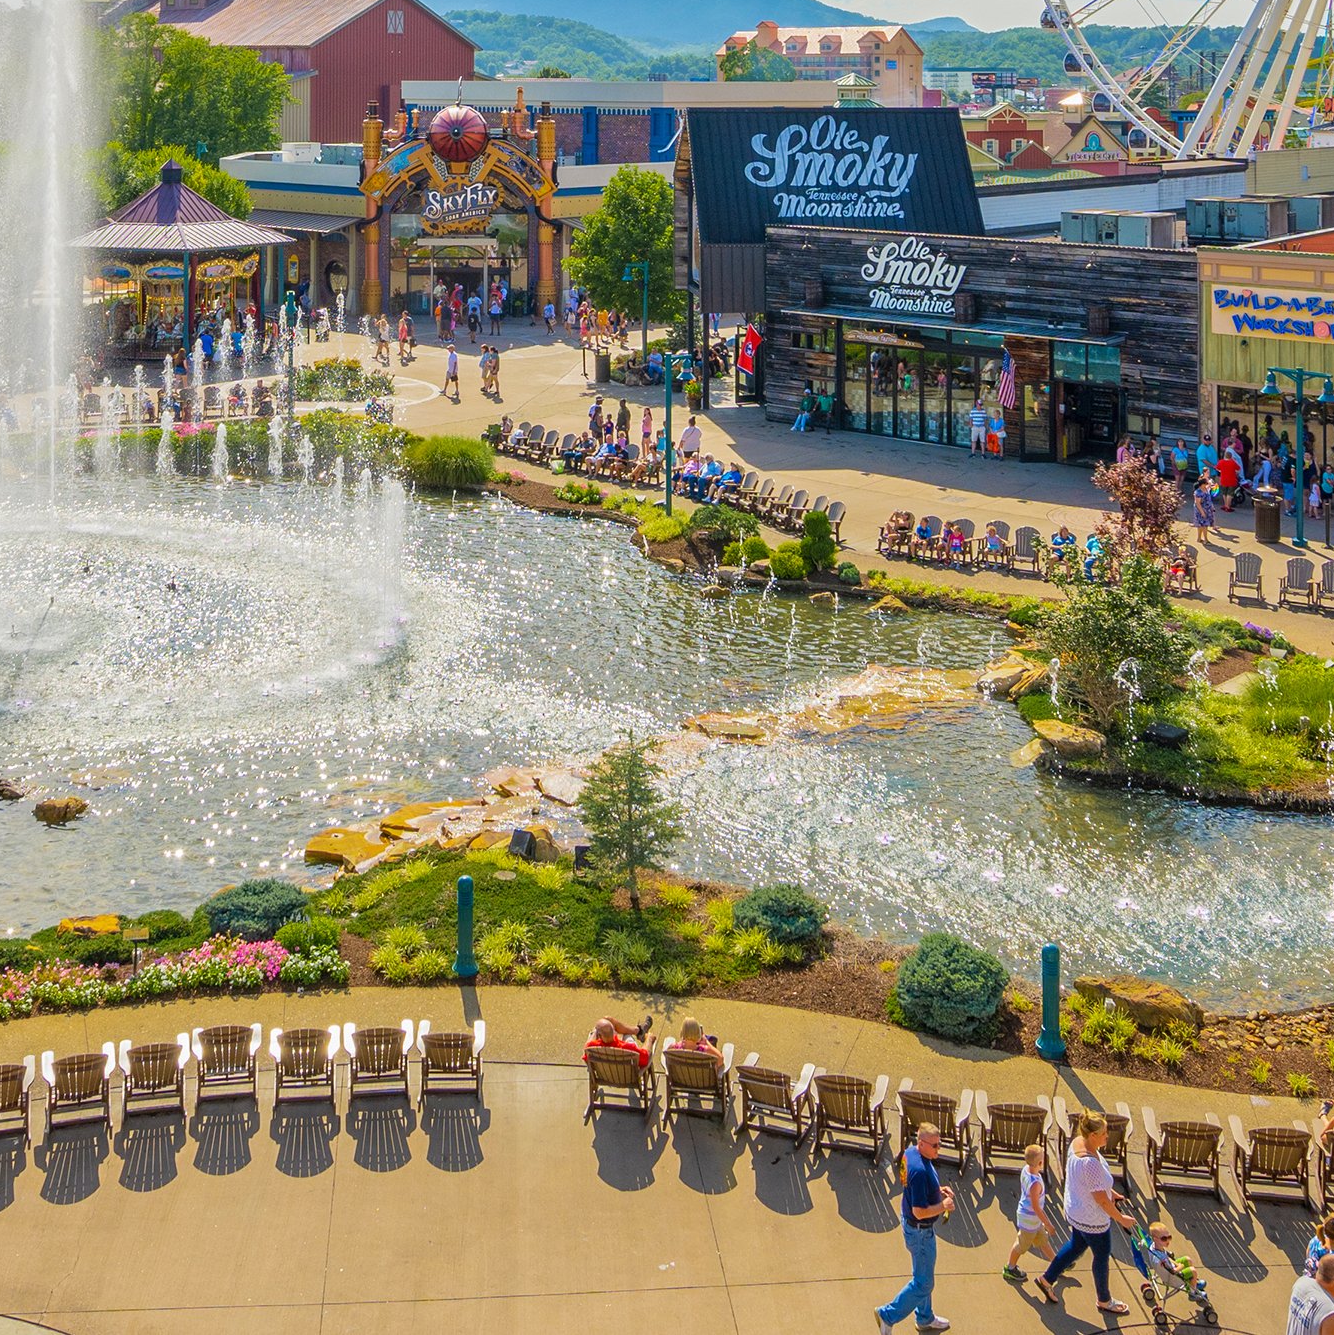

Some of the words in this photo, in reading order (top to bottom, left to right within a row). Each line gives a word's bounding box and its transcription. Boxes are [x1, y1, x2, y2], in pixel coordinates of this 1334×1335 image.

[809, 115, 869, 152] Ole
[744, 124, 918, 197] Smoky
[805, 187, 858, 201] Tennessee
[461, 209, 486, 218] AMERICA
[773, 196, 905, 219] Moonshine
[899, 236, 935, 262] Ole
[861, 242, 967, 296] Smoky
[869, 288, 955, 316] Moonshine
[890, 285, 926, 297] Tennessee
